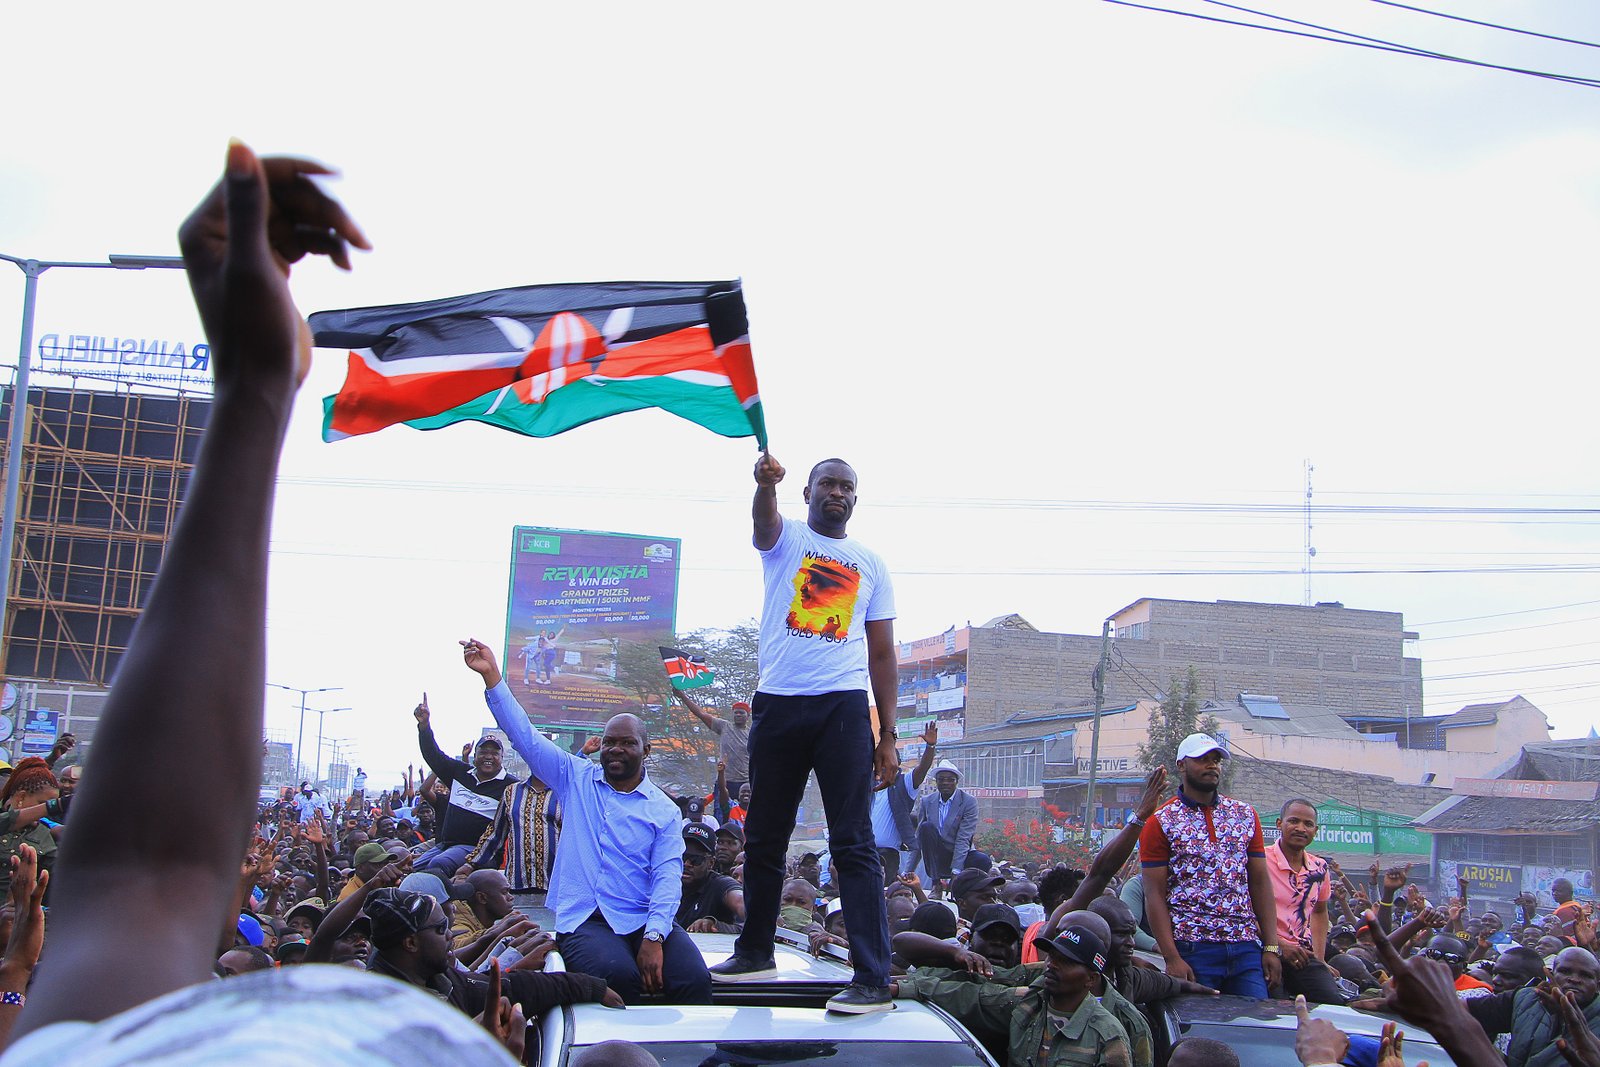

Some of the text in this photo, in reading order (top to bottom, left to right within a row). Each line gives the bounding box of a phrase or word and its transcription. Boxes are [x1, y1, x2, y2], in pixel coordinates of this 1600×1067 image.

[534, 539, 550, 549] KCB
[805, 549, 832, 563] WHO
[579, 577, 600, 586] WIN
[602, 577, 620, 586] BIG
[561, 588, 629, 598] GRAND PRIZES
[549, 598, 597, 606] APARTMENT
[601, 596, 622, 604] 500K
[786, 626, 848, 645] TOLD YOU?
[1313, 825, 1373, 844] afaricom
[1462, 866, 1513, 883] ARUSHA
